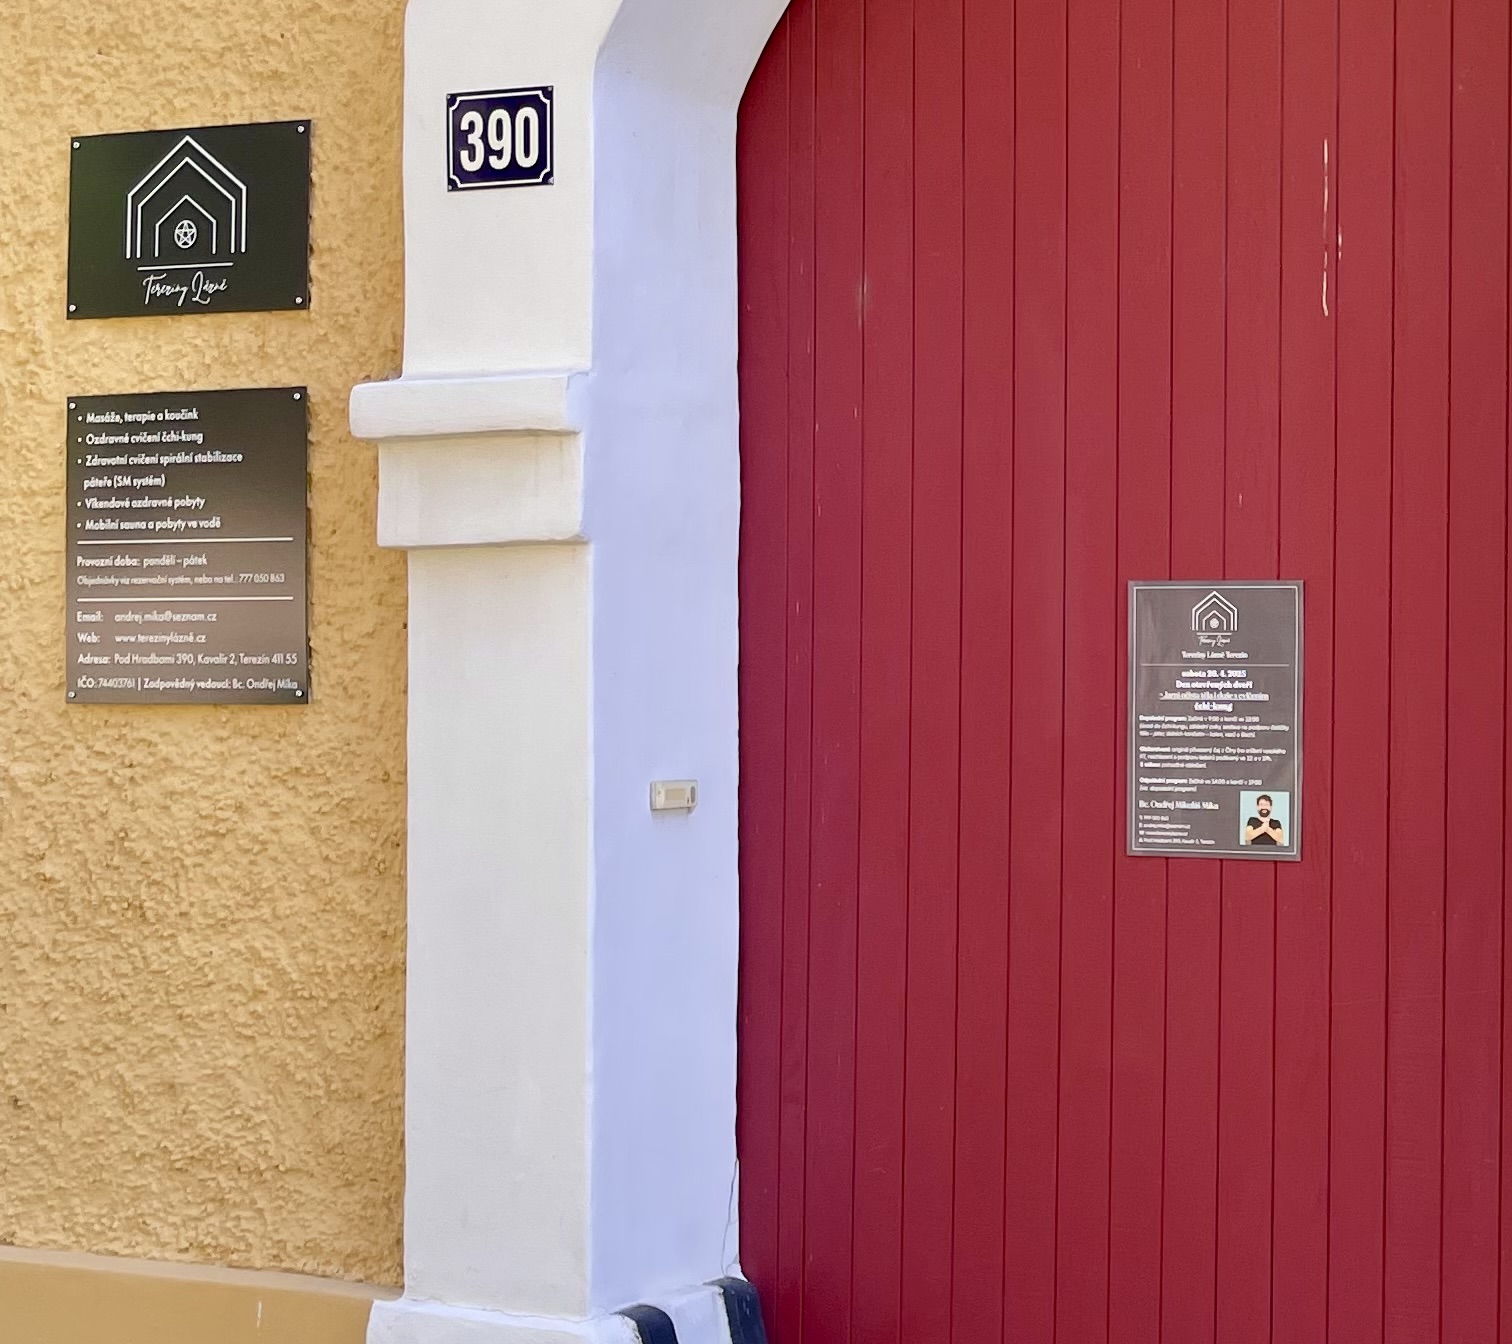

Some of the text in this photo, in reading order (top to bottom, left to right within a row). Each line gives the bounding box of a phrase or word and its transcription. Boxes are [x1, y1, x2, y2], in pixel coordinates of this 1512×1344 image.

[460, 106, 539, 172] 390
[85, 408, 199, 424] Masáže, terapie a koučink
[85, 430, 204, 445] Ozdravné cvičení čchi-kung
[85, 451, 243, 466] Zdravotní cvičení spirální stabilizace
[83, 474, 166, 491] páteře (SM systém)
[84, 494, 206, 510] Víkendové ozdravné pobyty
[85, 516, 221, 532] Mobilní sauna a pobyty ve vodě
[76, 555, 114, 567] Provozní
[114, 554, 141, 567] doba:
[182, 553, 208, 569] pátek
[194, 573, 213, 584] nebo
[213, 576, 224, 584] na
[238, 573, 254, 583] 777
[76, 610, 104, 622] Email:
[77, 631, 101, 643] Web:
[77, 652, 111, 664] Adresa:
[114, 652, 131, 664] Pod
[131, 652, 175, 664] Hradbami
[176, 652, 196, 665] 390,
[229, 653, 238, 666] 2,
[238, 652, 270, 664] Terezín
[271, 653, 284, 664] 411
[285, 653, 298, 664] 55
[196, 677, 232, 689] vedoucí:
[232, 678, 245, 689] Bc.
[246, 677, 276, 692] Ondřej
